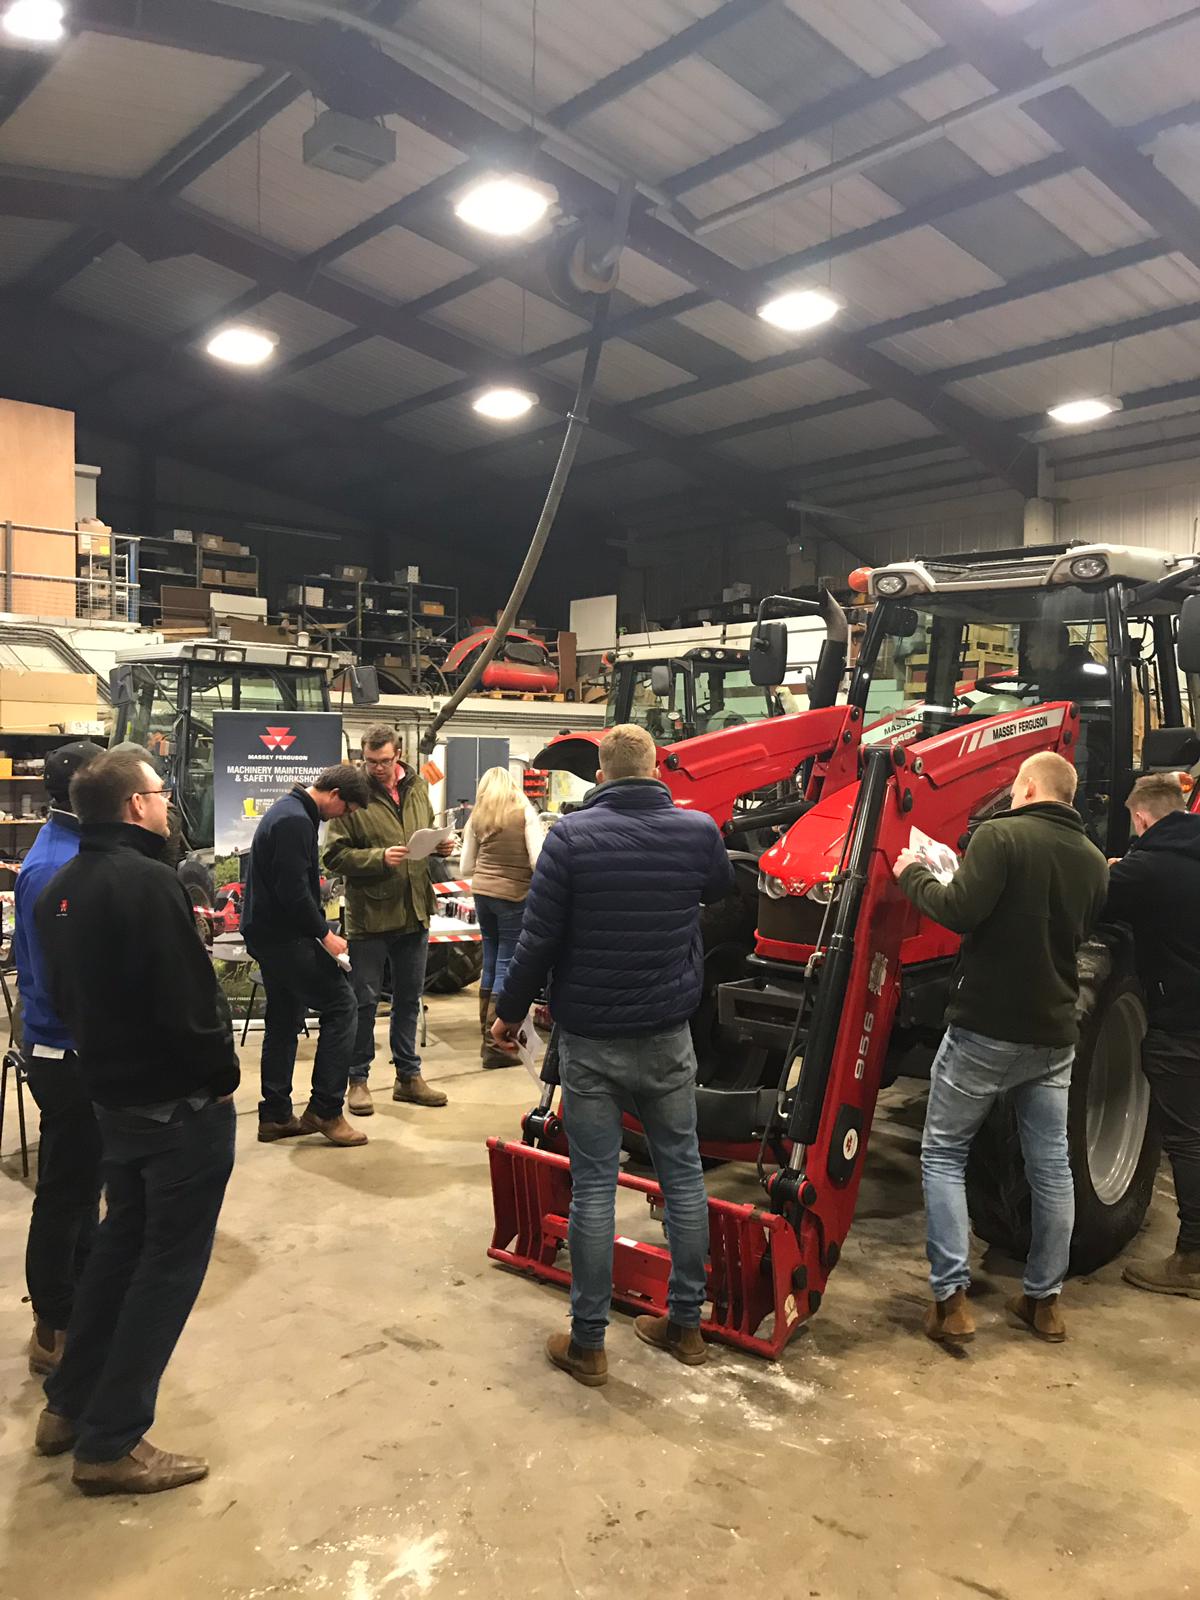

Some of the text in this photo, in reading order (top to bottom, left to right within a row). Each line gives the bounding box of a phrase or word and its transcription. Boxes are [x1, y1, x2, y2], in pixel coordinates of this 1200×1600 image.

[992, 715, 1048, 740] MASSEY FERGUSON
[226, 765, 328, 775] MACHINERY MAINTENANC
[234, 774, 242, 782] &
[243, 774, 273, 783] SAFETY
[854, 1011, 875, 1081] 956
